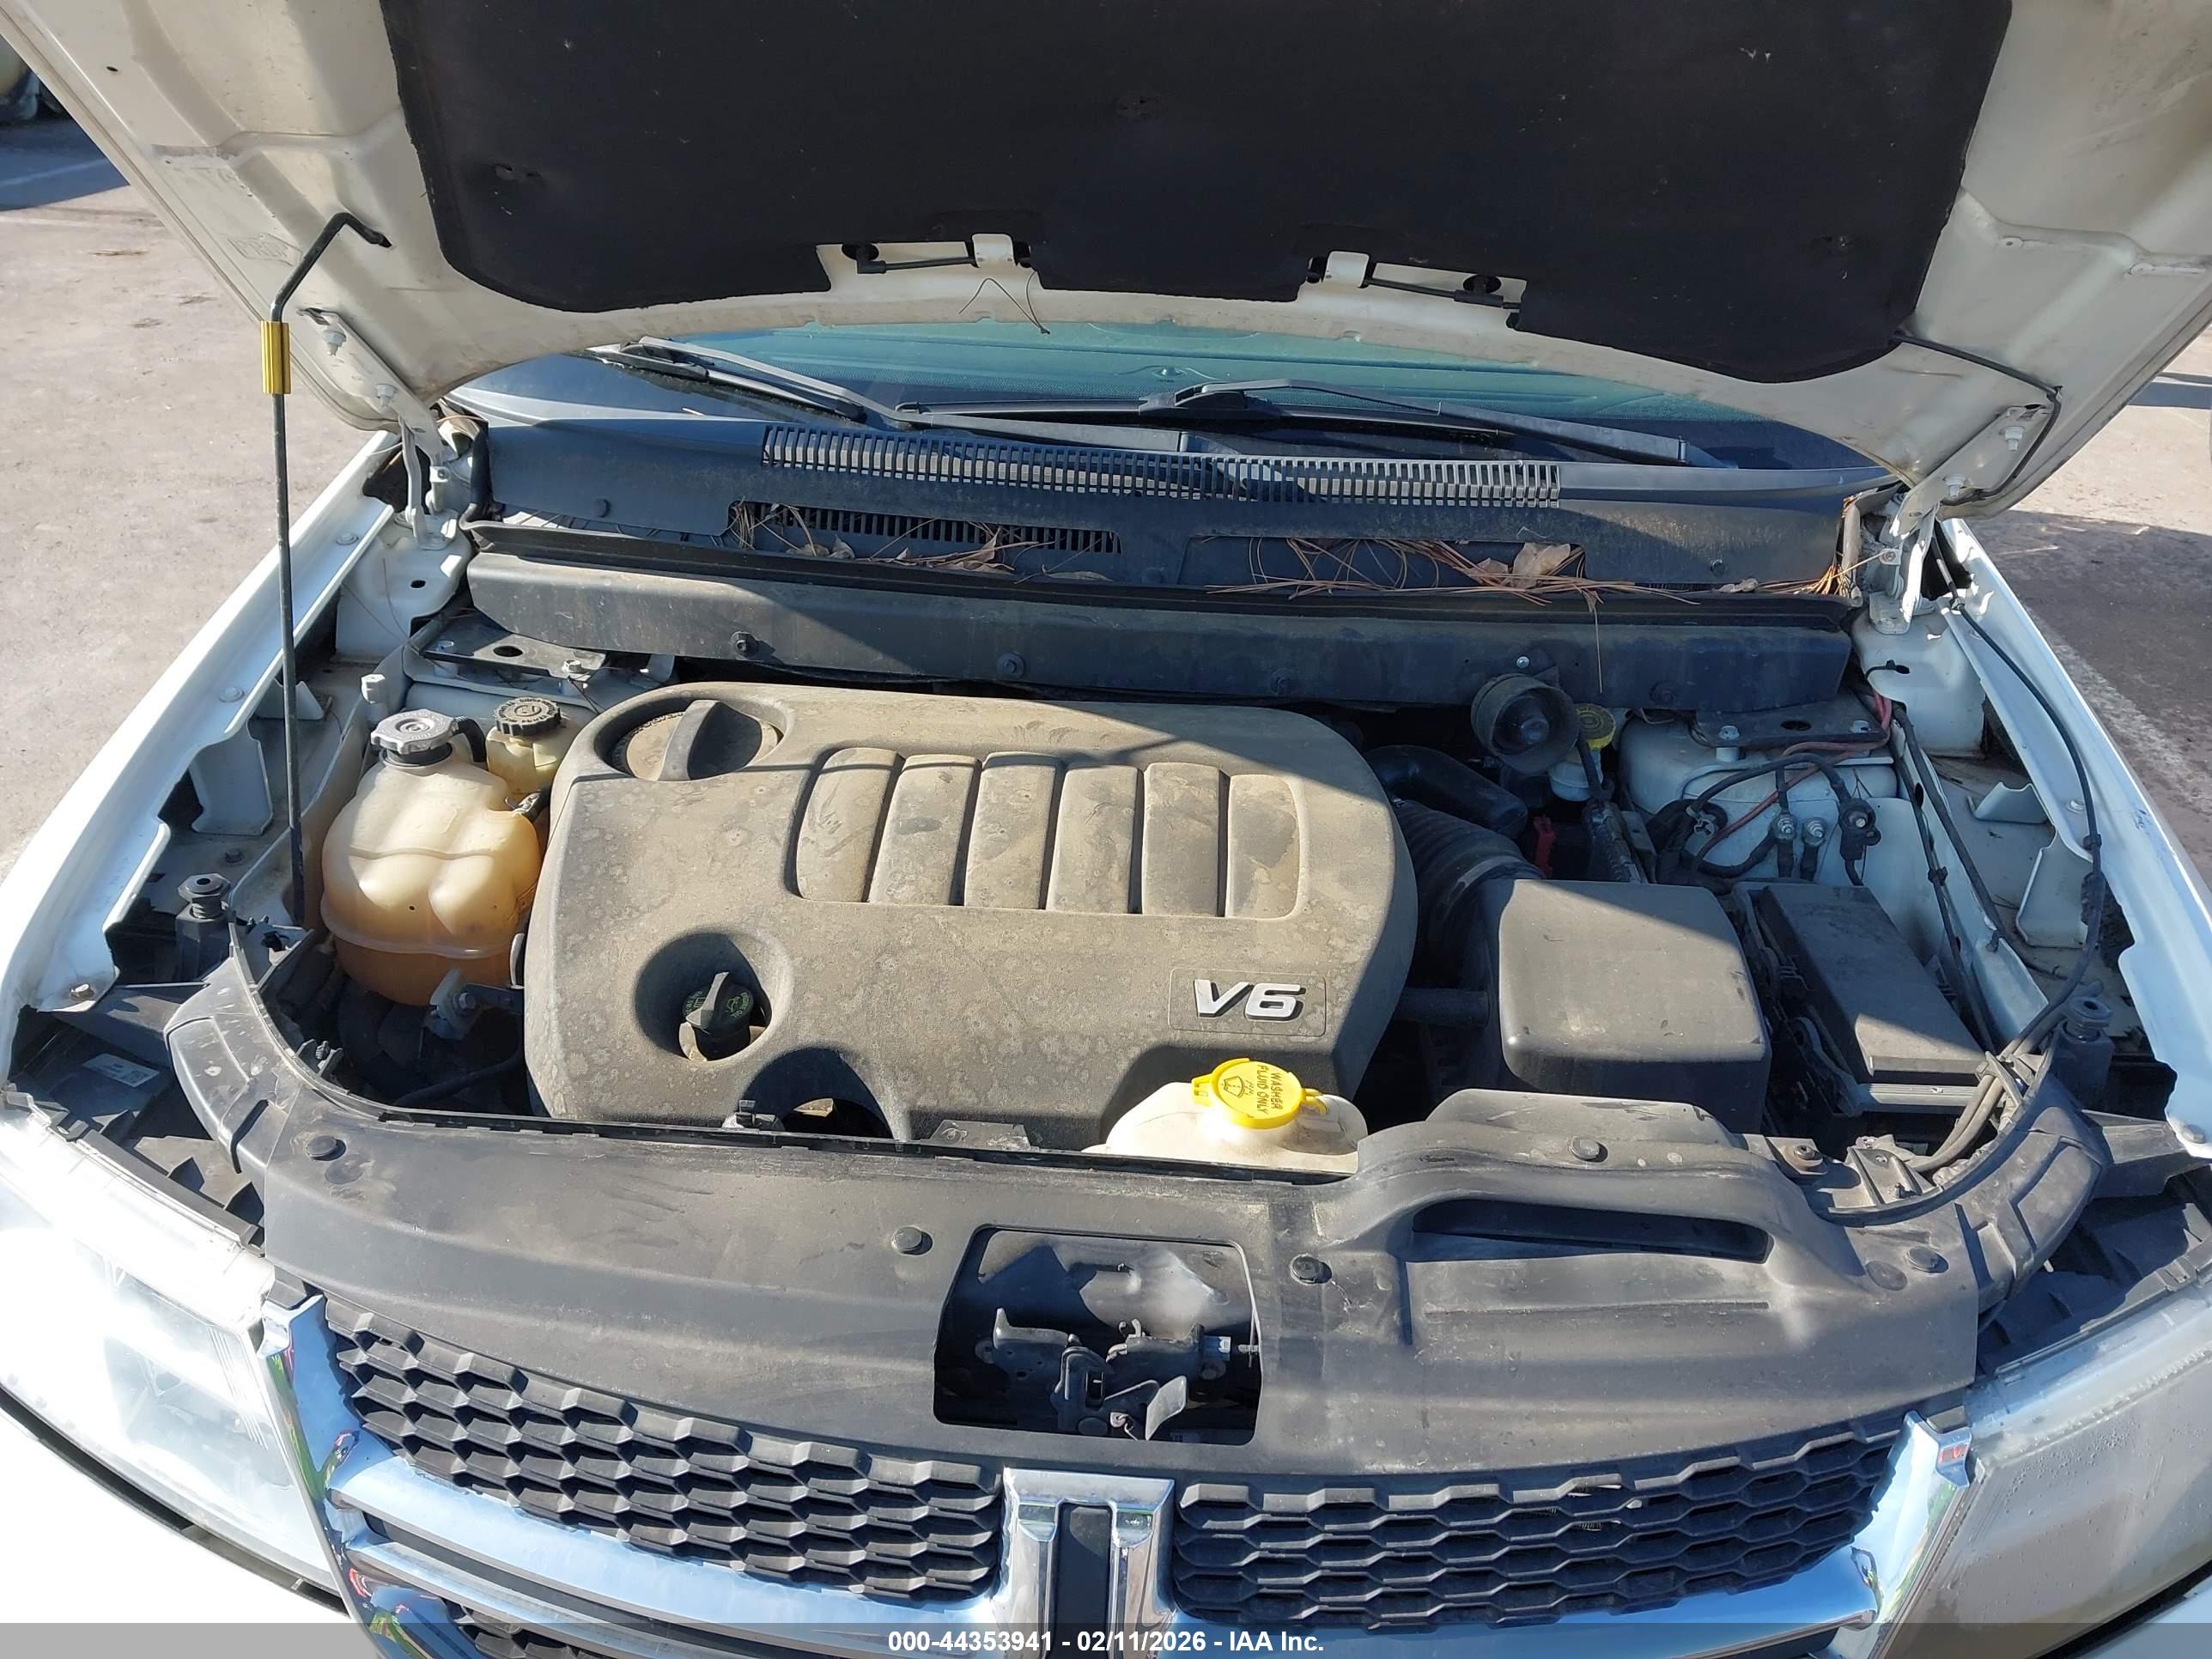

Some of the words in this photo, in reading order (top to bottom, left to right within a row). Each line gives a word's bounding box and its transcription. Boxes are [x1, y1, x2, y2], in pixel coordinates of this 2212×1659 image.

[1194, 979, 1304, 1019] V6
[1256, 1064, 1269, 1091] FLUID
[1270, 1072, 1284, 1110] WASHER
[1256, 1091, 1269, 1115] ONLY
